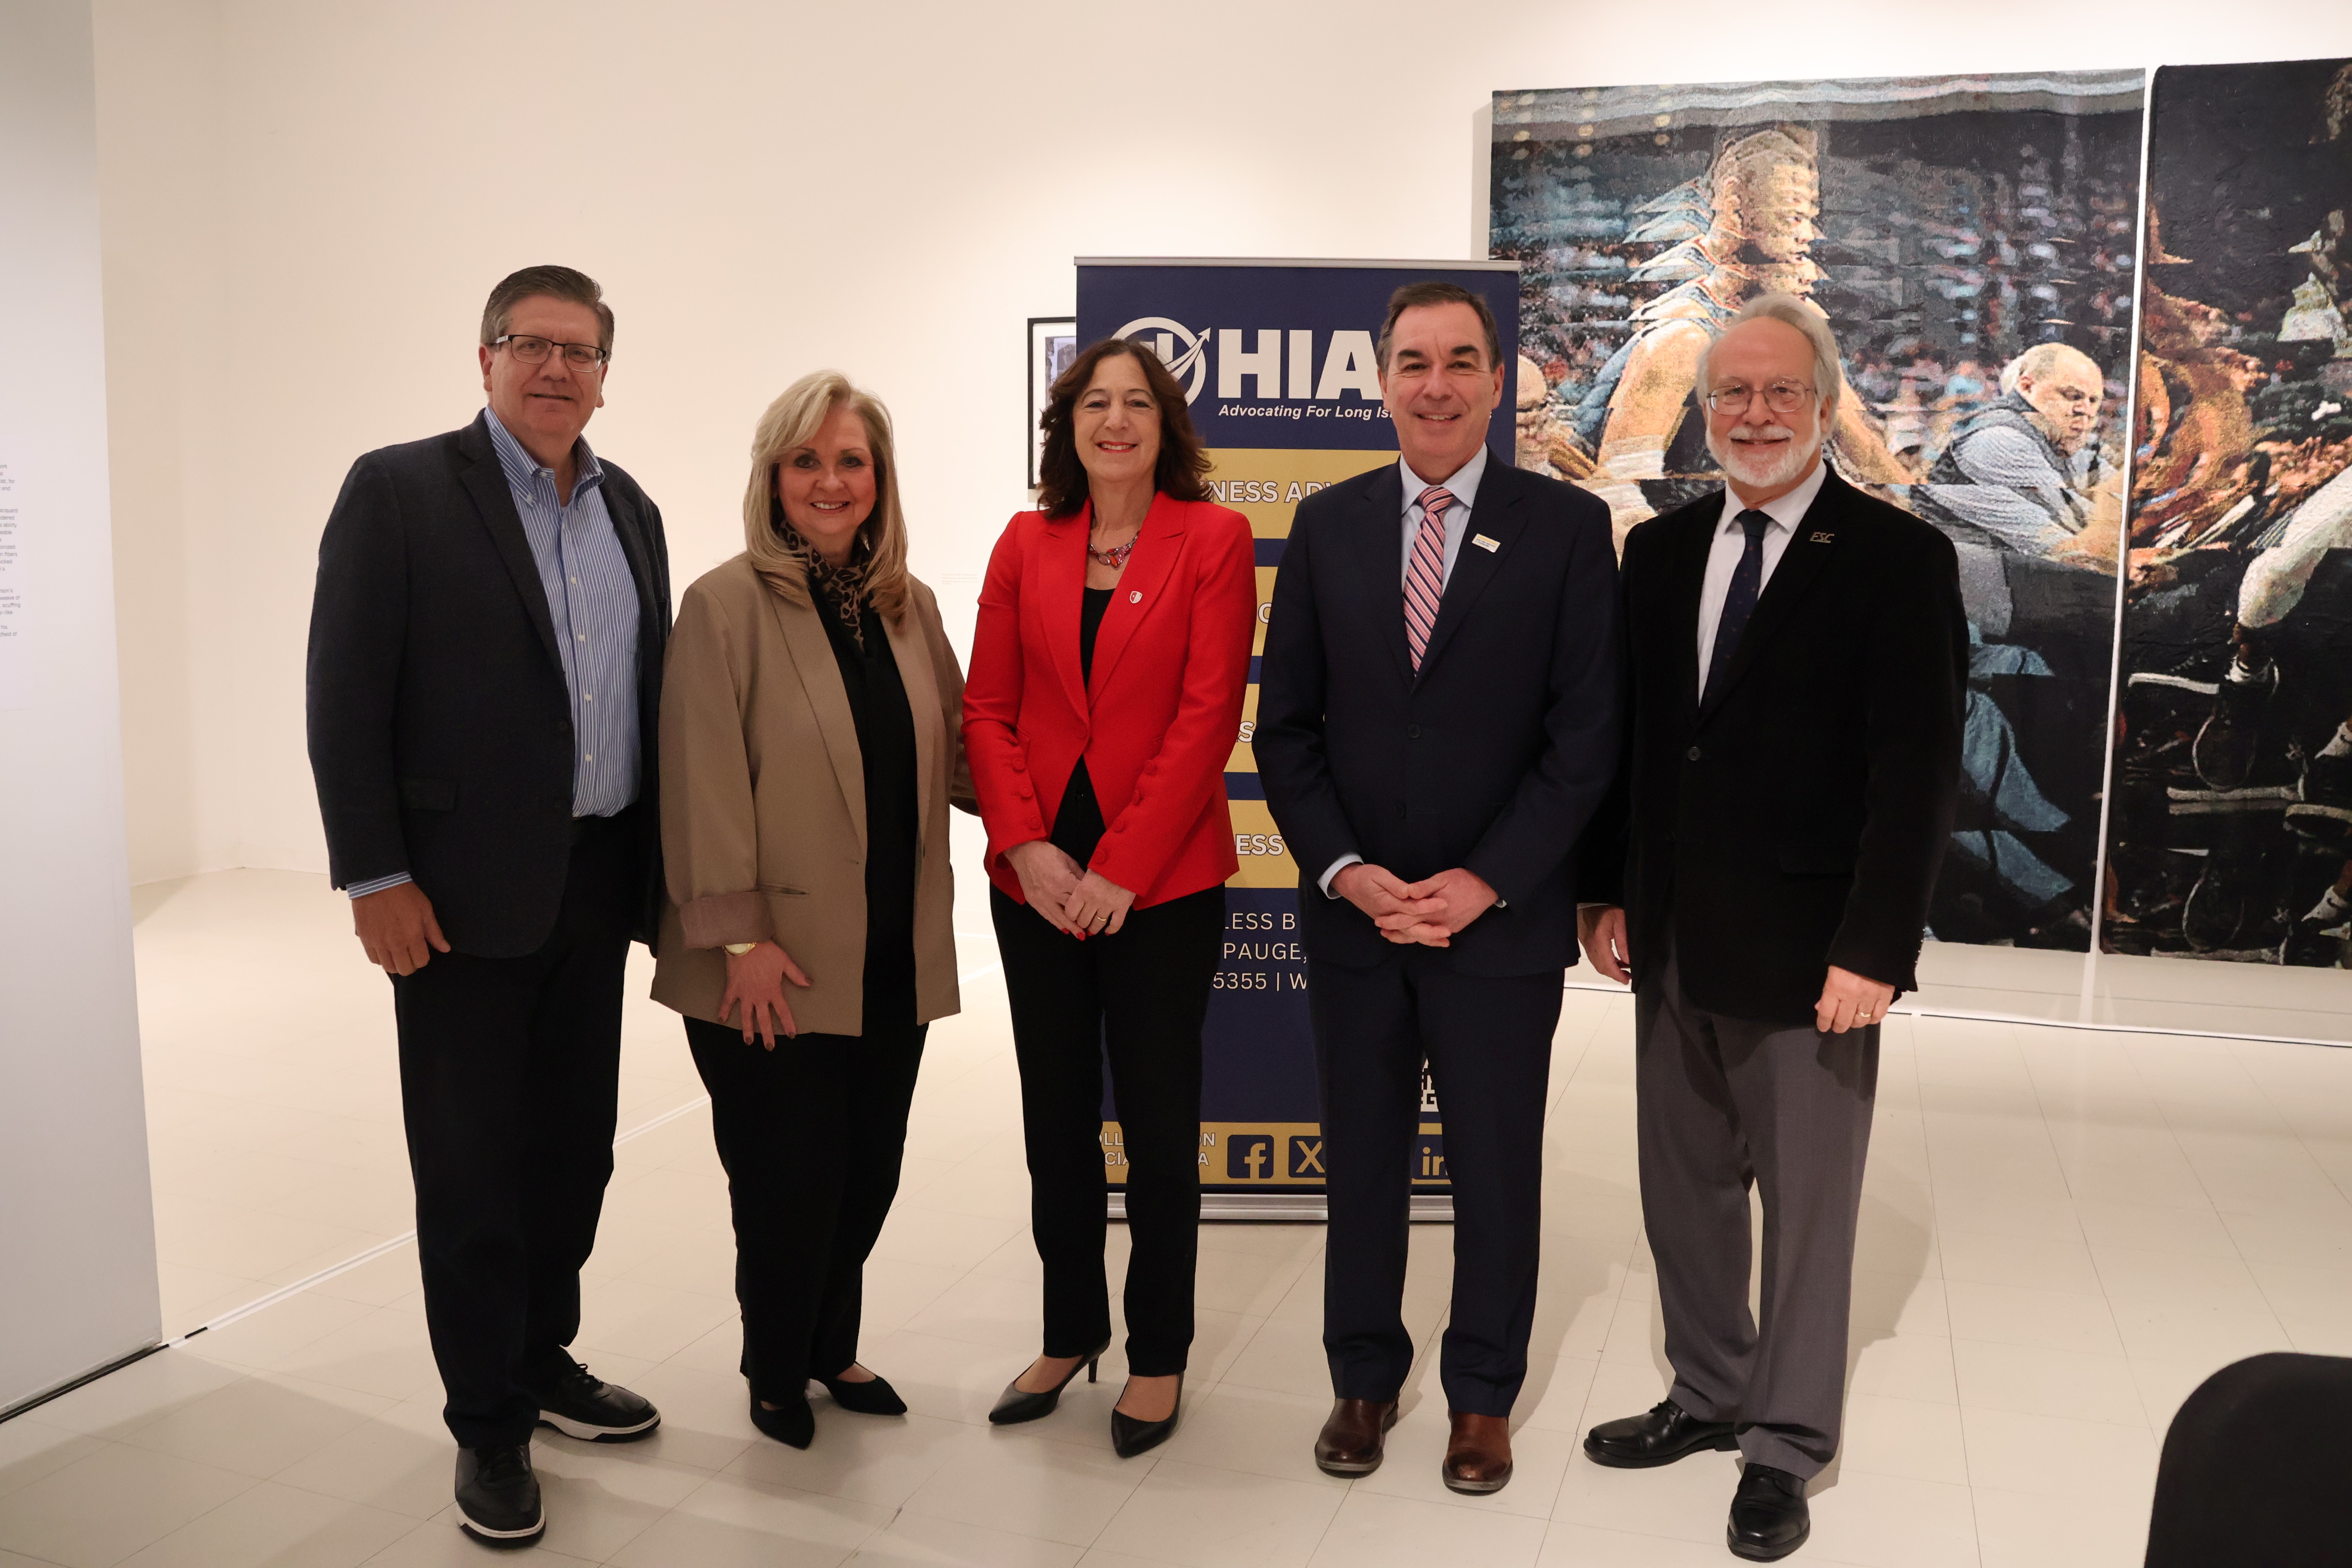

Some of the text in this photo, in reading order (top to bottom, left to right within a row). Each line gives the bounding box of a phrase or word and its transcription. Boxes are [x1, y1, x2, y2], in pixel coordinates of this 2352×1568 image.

[1218, 404, 1301, 419] Advocating
[1306, 405, 1331, 417] For
[1335, 406, 1372, 420] Long
[1284, 481, 1331, 503] AD
[1225, 913, 1273, 930] ESS
